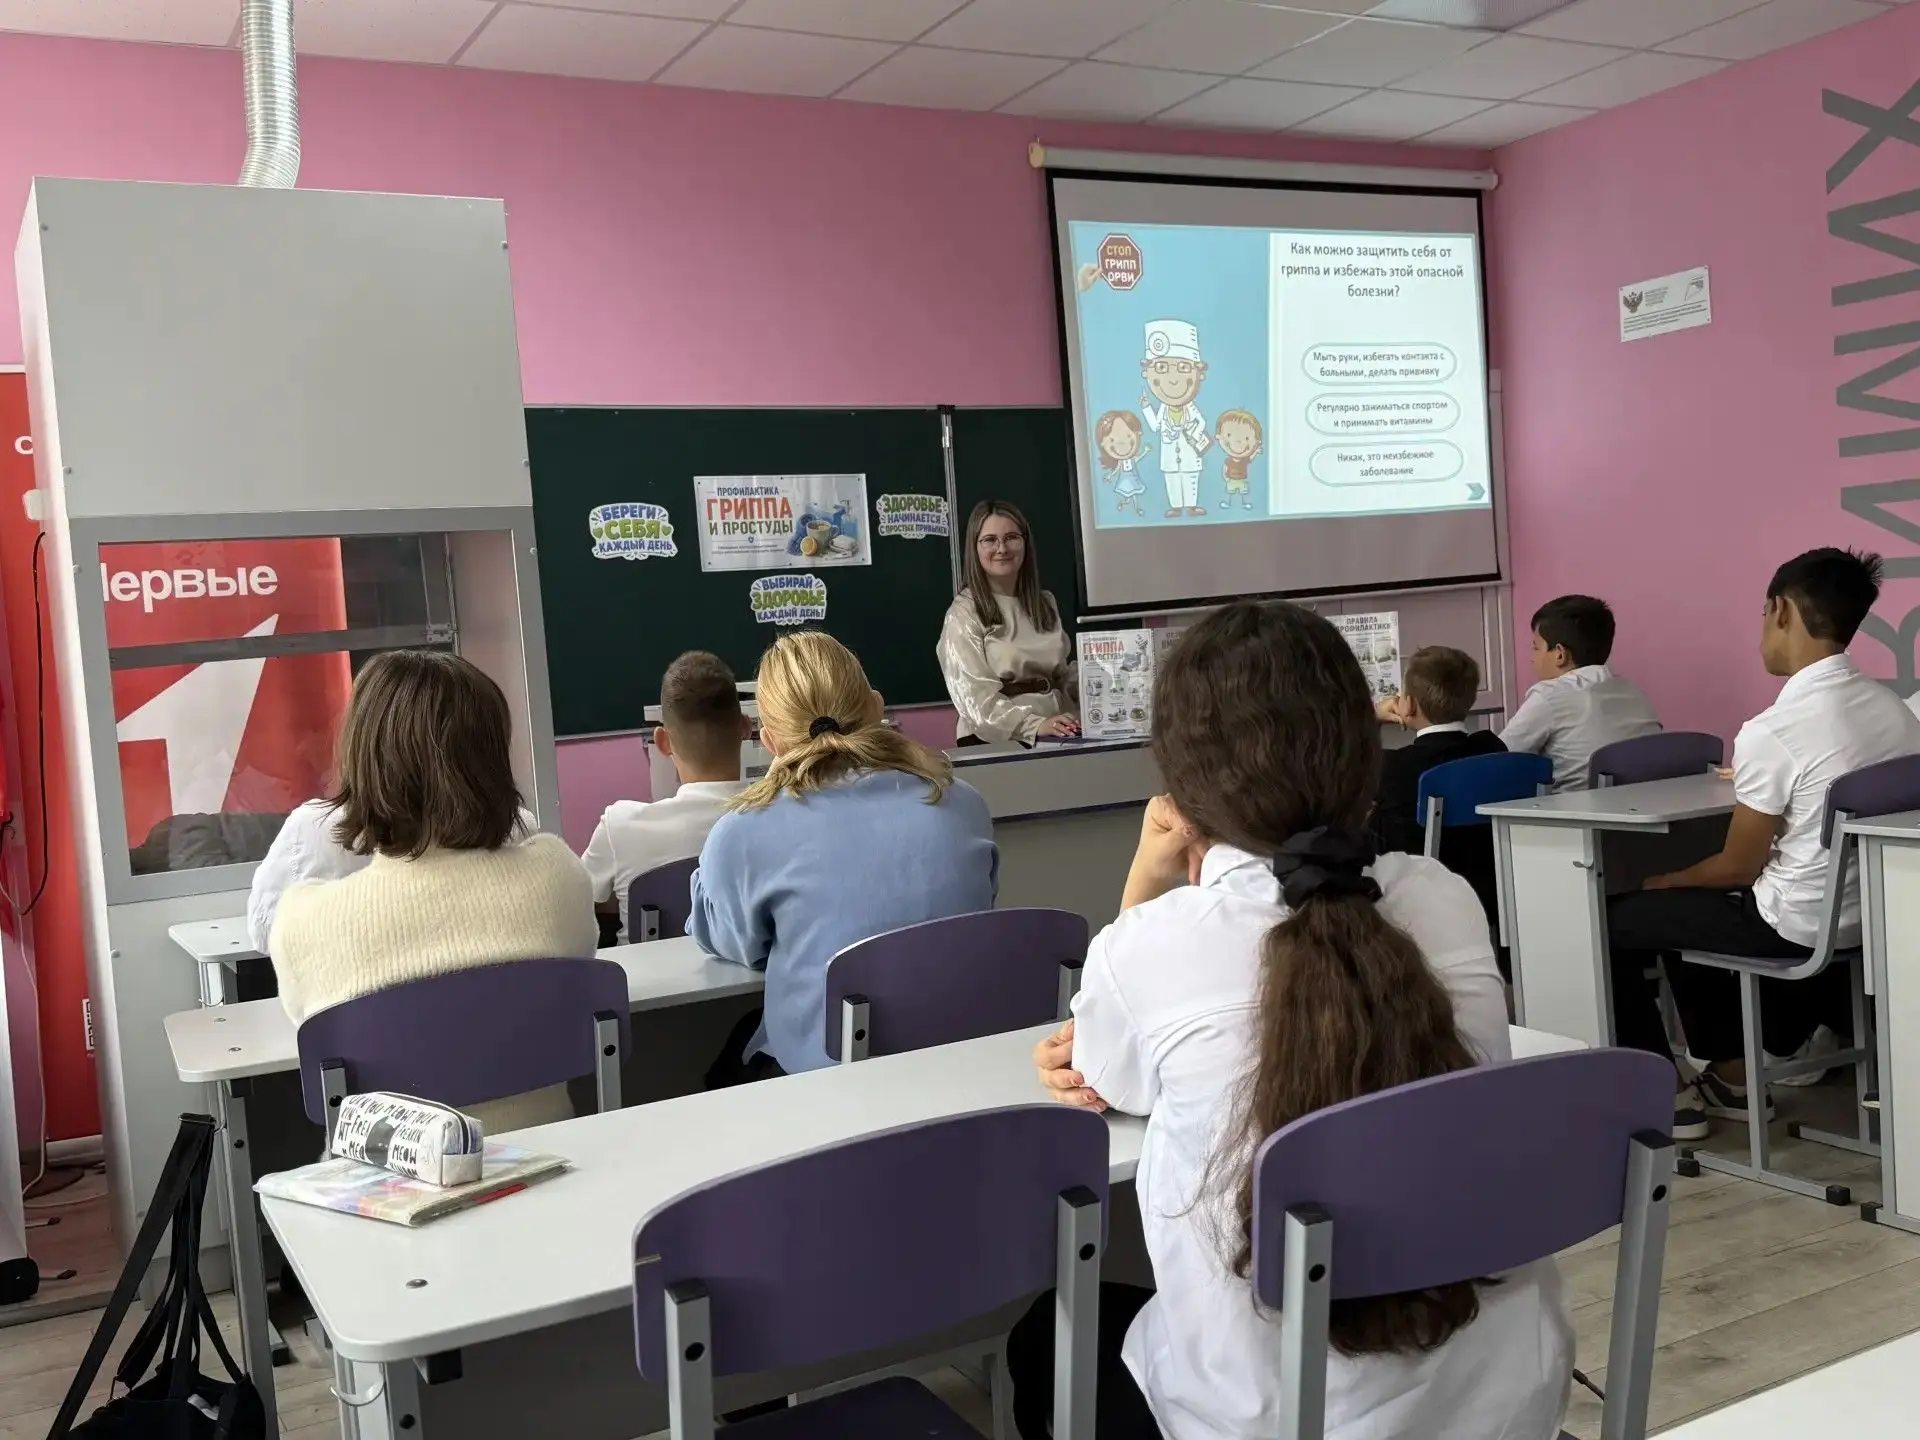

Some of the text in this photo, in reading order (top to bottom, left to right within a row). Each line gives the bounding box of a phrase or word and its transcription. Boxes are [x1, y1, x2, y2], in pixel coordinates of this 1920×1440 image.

[1106, 245, 1132, 256] СТОП
[1291, 242, 1452, 259] Как можно защитить себя от
[1104, 259, 1136, 269] ГРИПП
[1107, 272, 1135, 283] ОРВИ
[1281, 264, 1464, 278] гриппа и избежать этой опасной
[1348, 284, 1400, 297] болезни?
[1313, 352, 1337, 361] Мыть
[1339, 353, 1361, 364] руки,
[1363, 352, 1399, 361] избегать
[1402, 352, 1438, 361] контакта
[1320, 367, 1440, 377] больными, делать прививку
[1317, 401, 1448, 413] Регулярно заниматься спортом
[1341, 419, 1388, 429] принимать
[1390, 417, 1433, 426] витамины
[1337, 450, 1434, 462] Никак, это неизбежное
[1360, 466, 1414, 477] заболевание
[717, 486, 779, 496] ПРОФИЛАКТИКА
[706, 497, 794, 520] ГРИППА
[882, 496, 942, 513] ЗДОРОВЬЕ
[600, 505, 657, 521] БЕРЕГИ
[887, 512, 940, 523] НАЧИНАЕТСЯ
[604, 519, 660, 540] СЕБЯ
[709, 520, 793, 536] И ПРОСТУДЫ
[599, 539, 673, 553] КАЖДЫЙ ДЕНЬ
[761, 576, 813, 591] ВЫБИРАЙ
[752, 589, 825, 610] ЗДОРОВЬЕ
[757, 607, 798, 620] КАЖДЫЙ
[392, 1144, 418, 1165] MEOW
